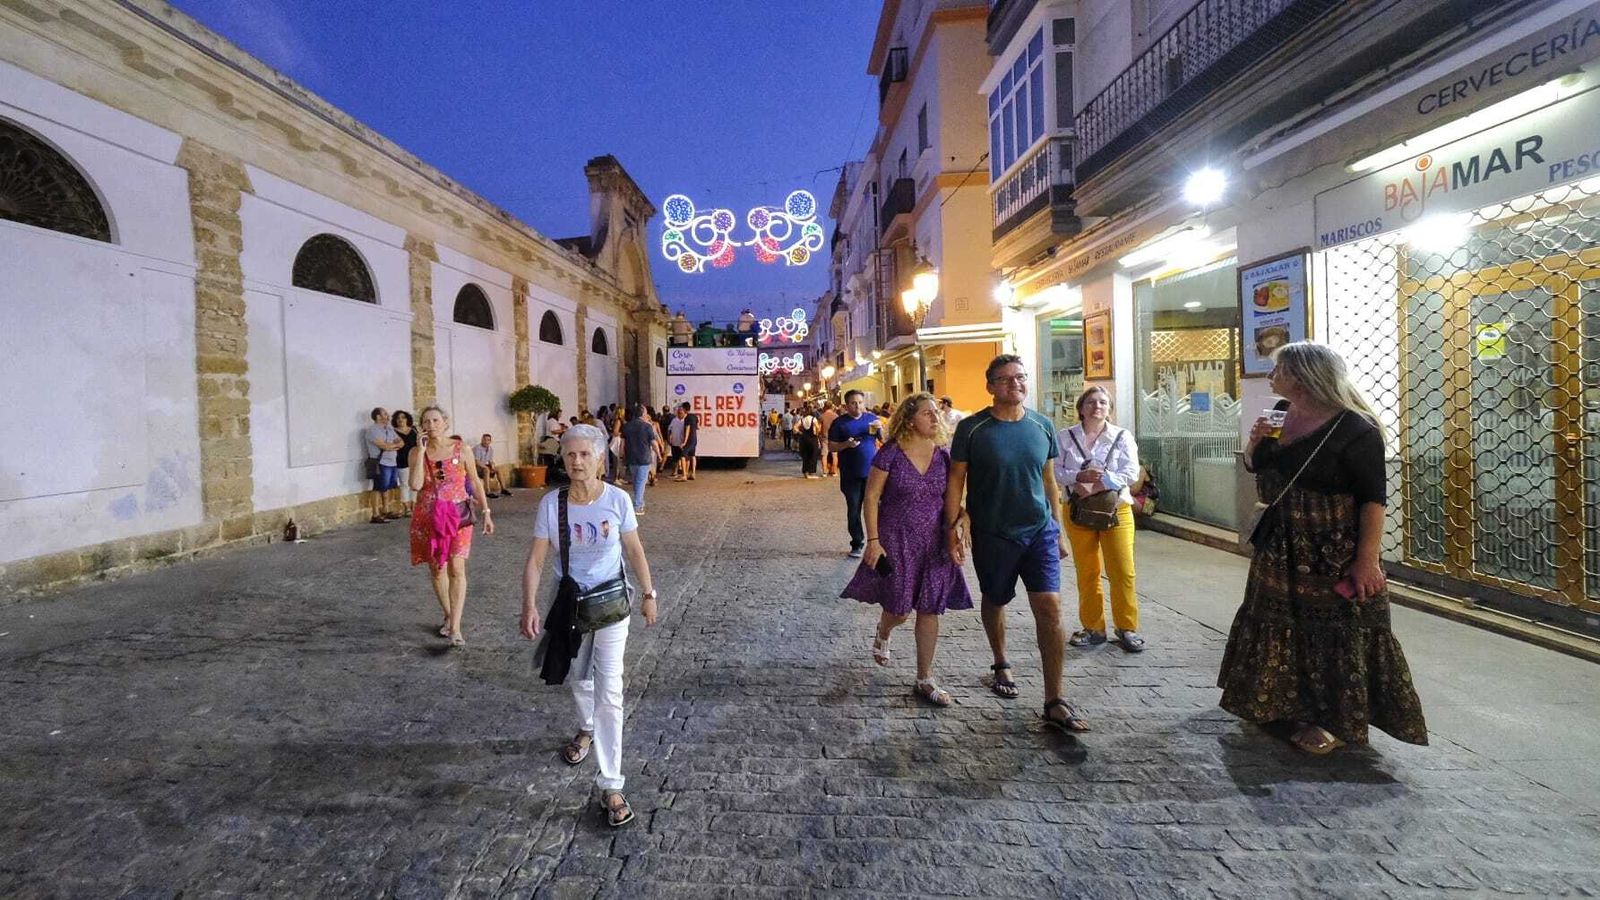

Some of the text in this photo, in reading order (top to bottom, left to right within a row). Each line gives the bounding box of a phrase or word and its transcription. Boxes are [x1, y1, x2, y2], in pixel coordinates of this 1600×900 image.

[1418, 20, 1600, 115] CERVECERÍA
[1320, 217, 1383, 247] MARISCOS
[693, 395, 745, 410] EL REY
[716, 413, 757, 428] OROS
